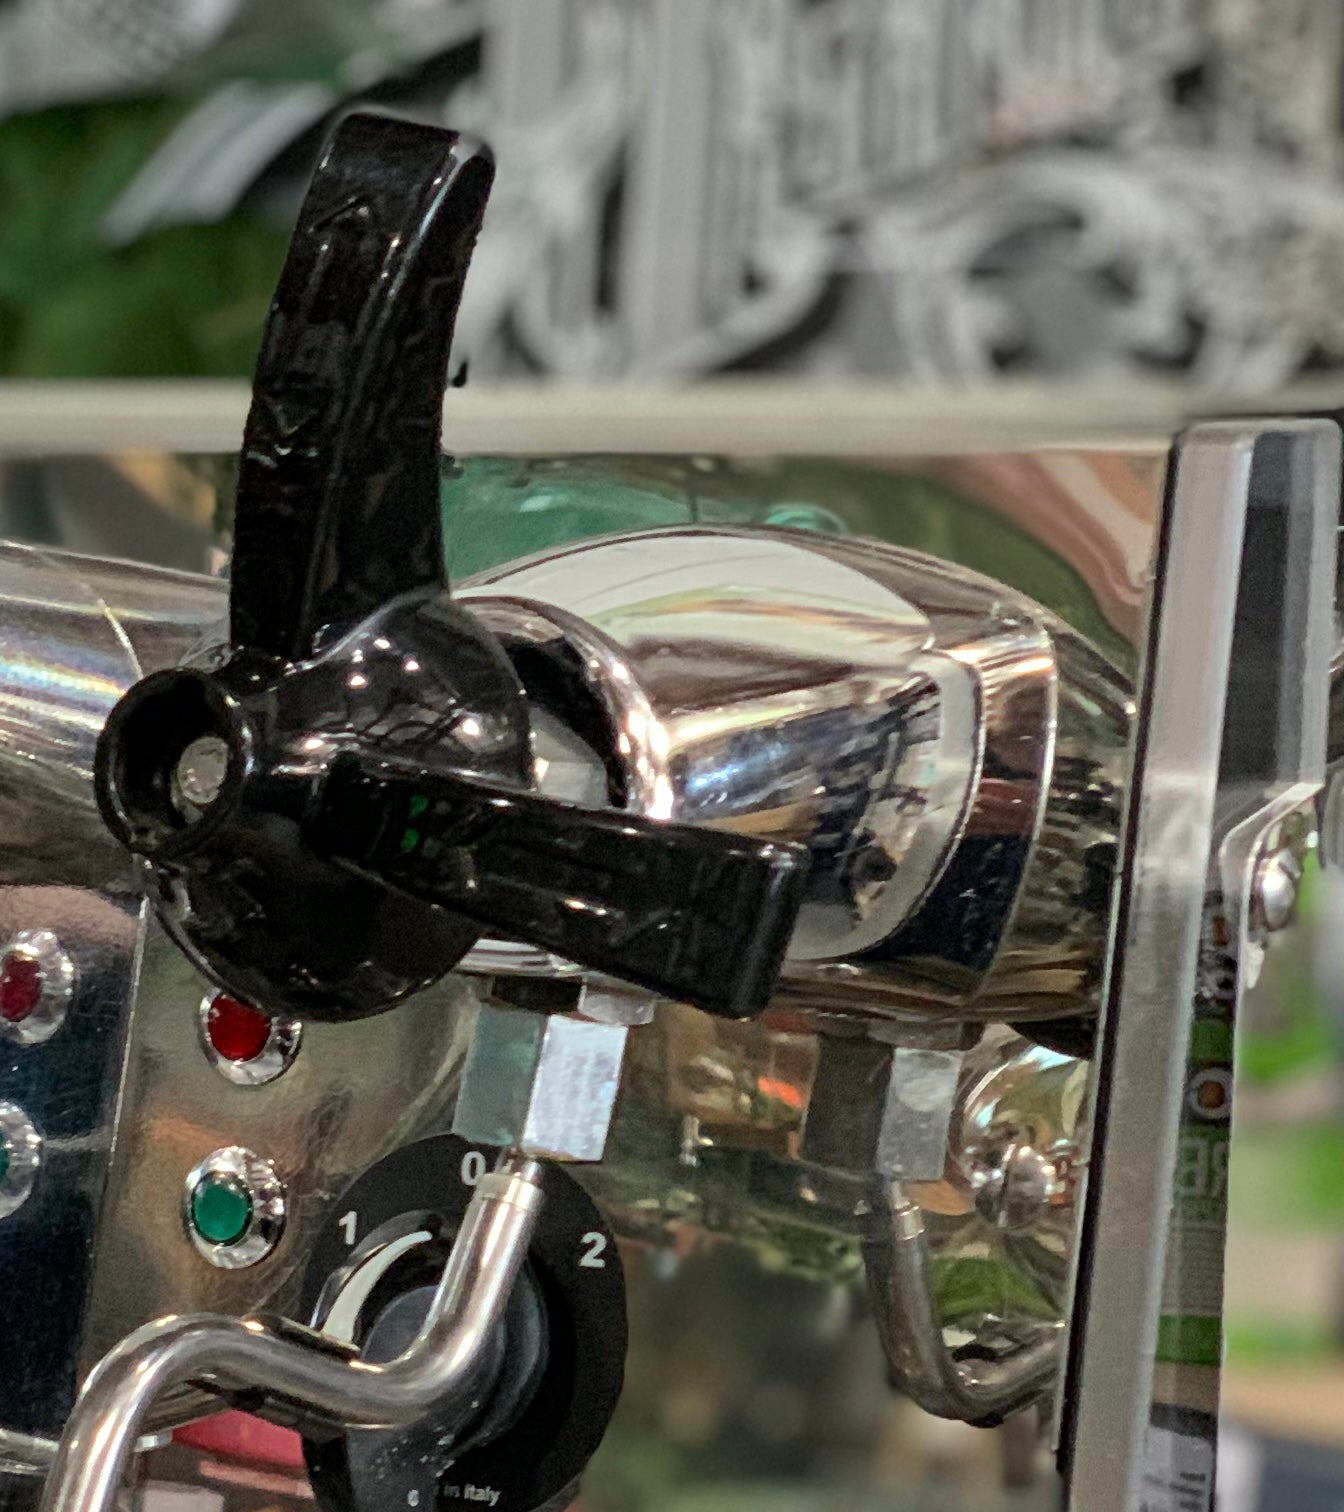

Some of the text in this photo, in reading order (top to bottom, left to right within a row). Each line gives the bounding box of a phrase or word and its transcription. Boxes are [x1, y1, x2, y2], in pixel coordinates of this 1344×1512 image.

[461, 1150, 486, 1186] 0
[338, 1210, 358, 1245] 1
[578, 1231, 607, 1268] 2
[463, 1483, 502, 1507] Italy
